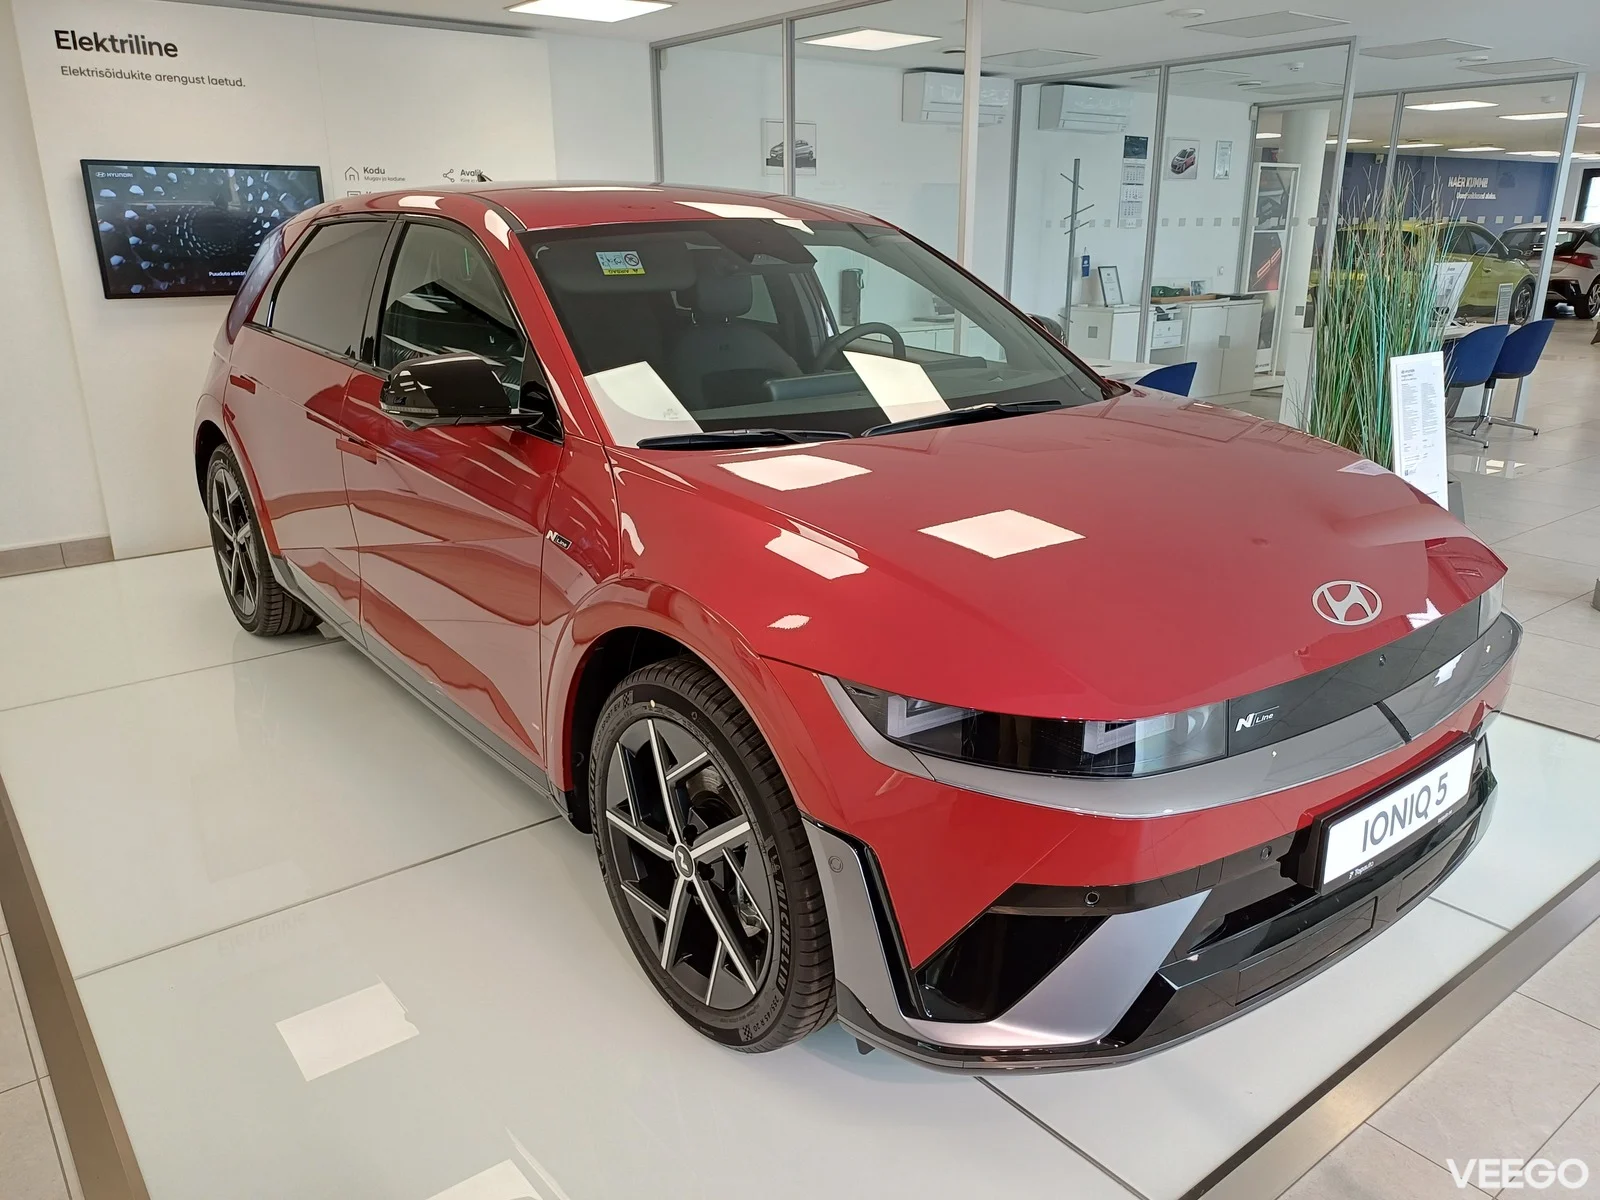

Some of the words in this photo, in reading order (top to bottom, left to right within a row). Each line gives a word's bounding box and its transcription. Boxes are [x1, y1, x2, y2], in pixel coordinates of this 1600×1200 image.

[54, 29, 179, 58] Elektriline
[60, 65, 152, 81] Elektrisõidukite
[154, 73, 206, 86] arengust
[207, 75, 246, 87] laetud.
[363, 166, 386, 175] Kodu
[1235, 713, 1255, 732] N
[1255, 713, 1274, 724] Line
[1362, 785, 1431, 853] IONIQ
[1435, 772, 1448, 806] 5
[775, 878, 790, 990] MICHELIN
